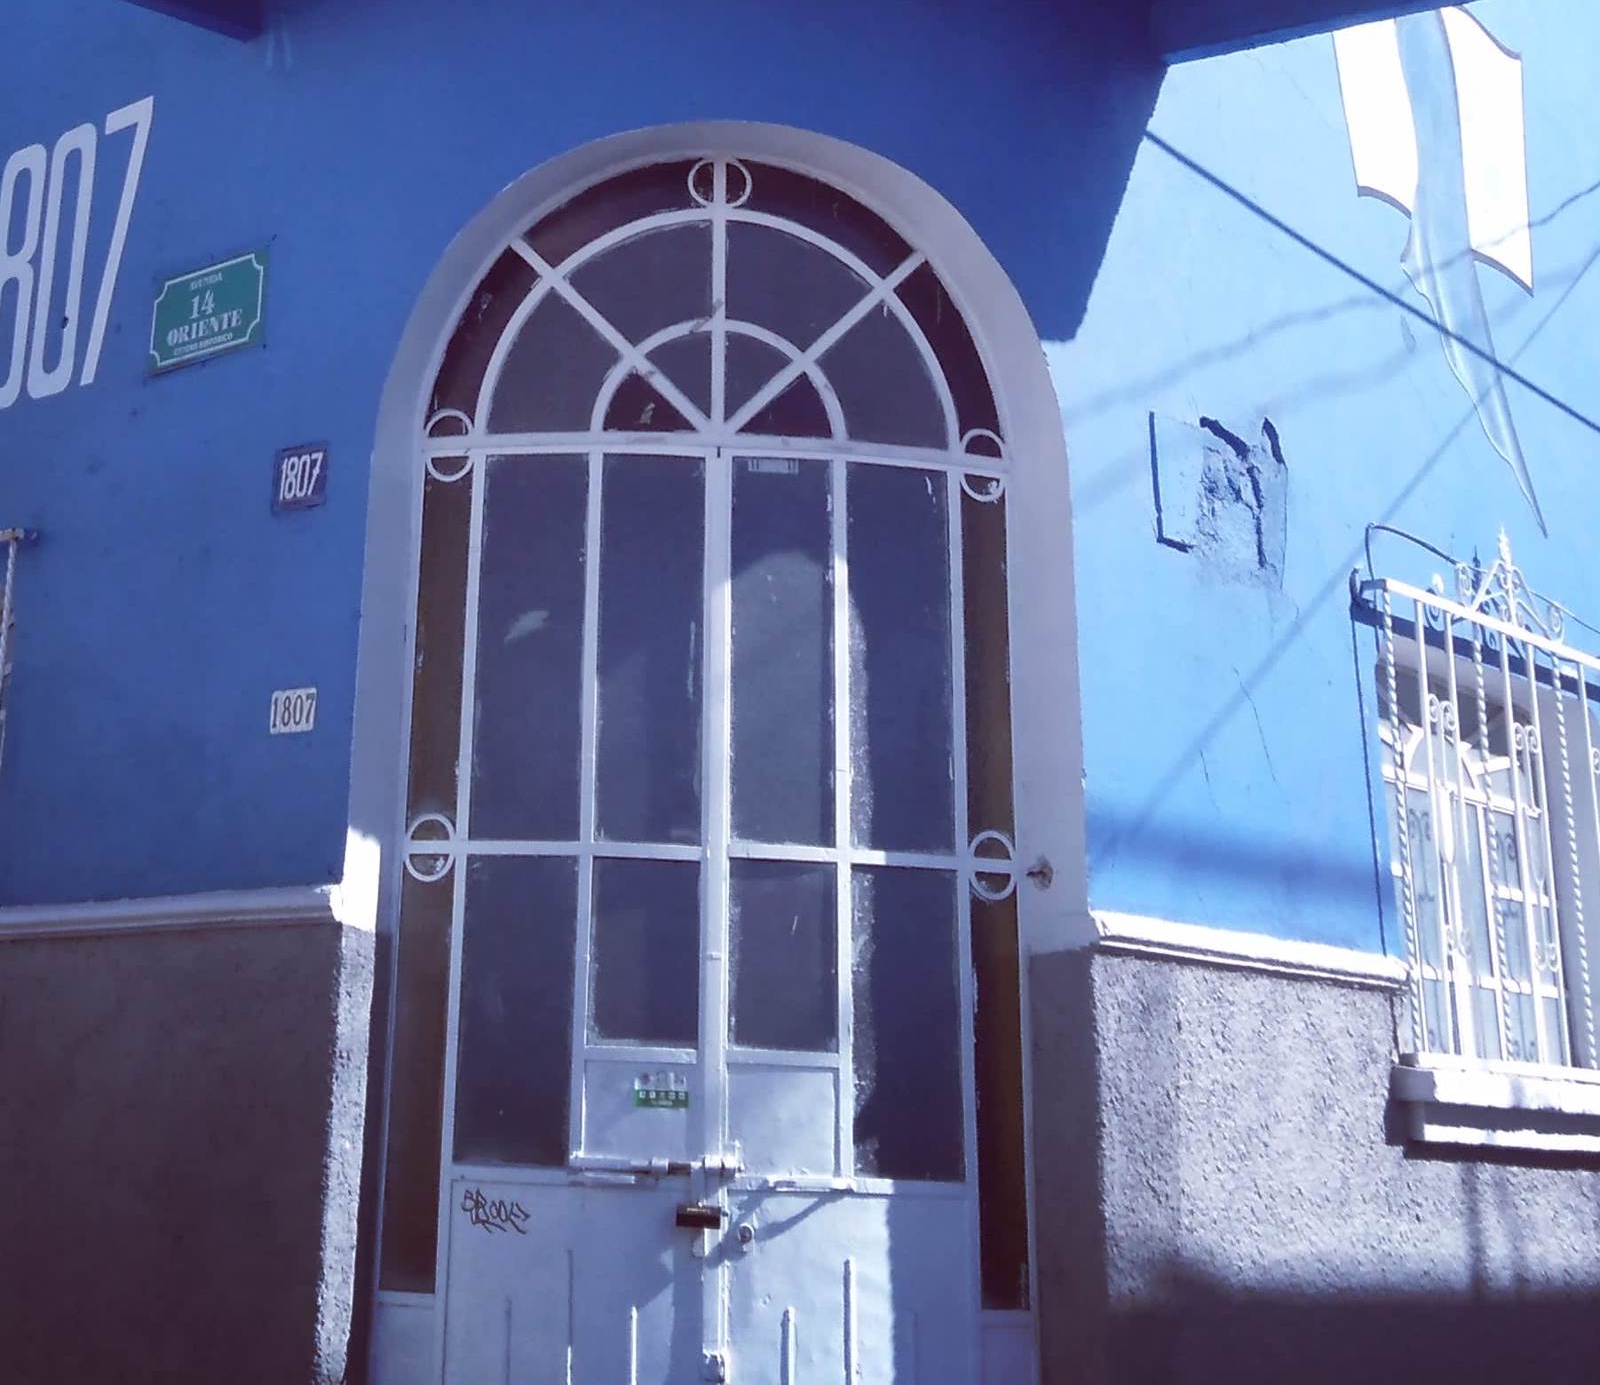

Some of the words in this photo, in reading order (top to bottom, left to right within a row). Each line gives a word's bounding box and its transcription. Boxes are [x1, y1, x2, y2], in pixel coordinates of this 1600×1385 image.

[189, 289, 215, 319] 14
[167, 308, 243, 346] ORIENTE
[279, 451, 324, 501] 1807
[271, 692, 316, 729] 1807
